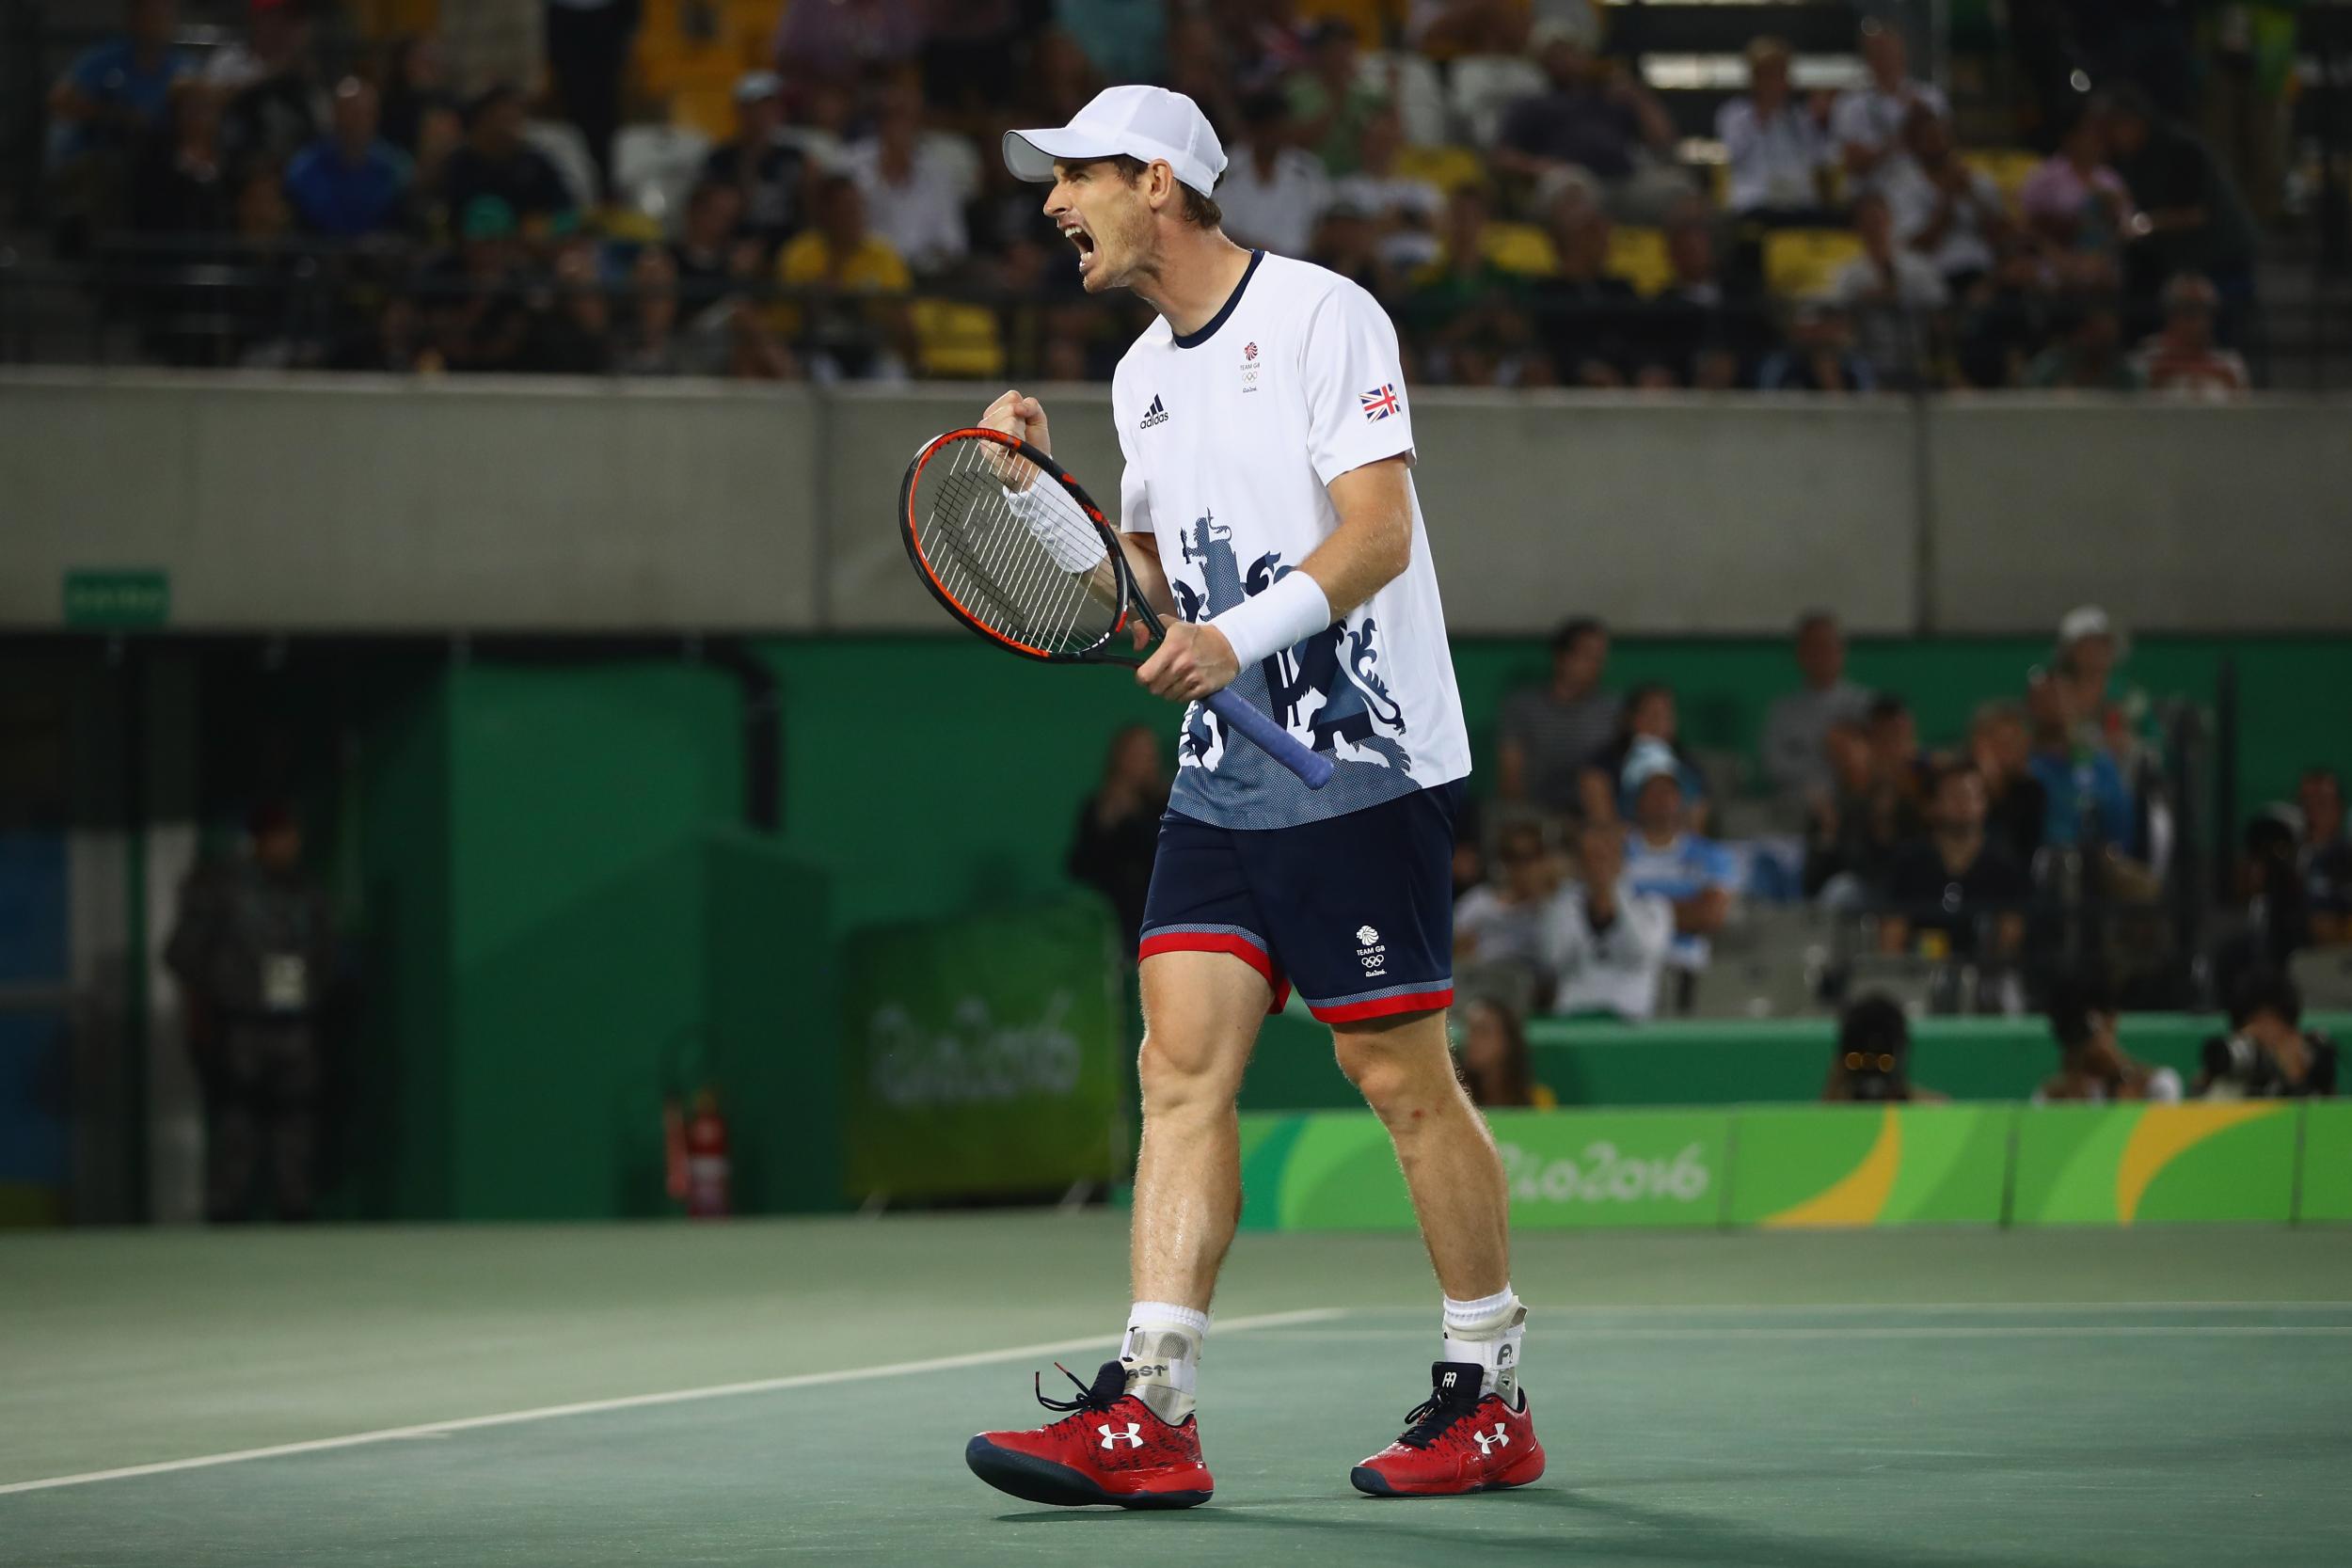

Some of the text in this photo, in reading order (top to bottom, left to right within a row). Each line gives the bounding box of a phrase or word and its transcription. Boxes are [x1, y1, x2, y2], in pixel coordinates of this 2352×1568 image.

[1139, 412, 1169, 429] adidas
[1357, 944, 1386, 956] TEAM GB
